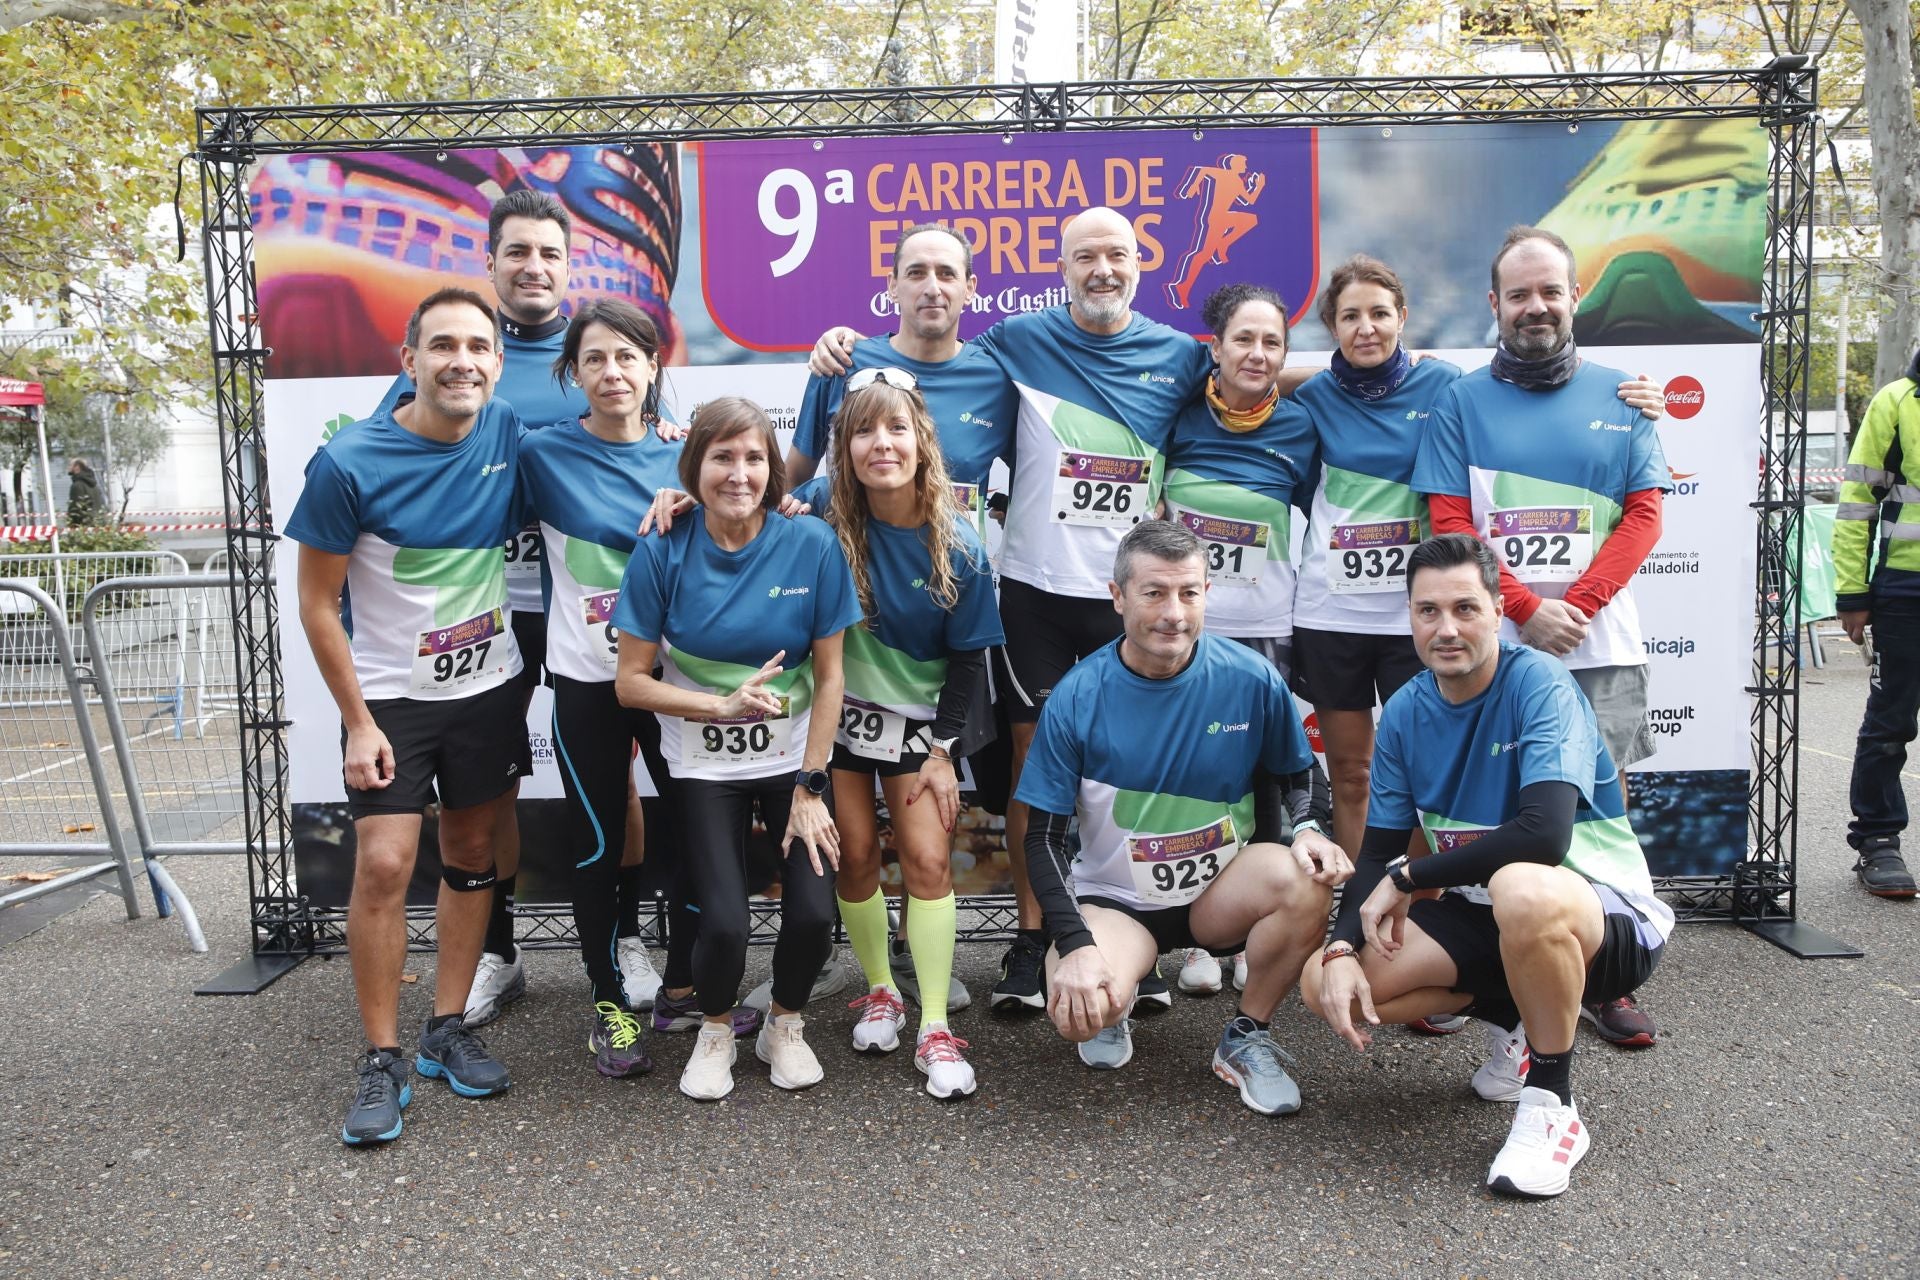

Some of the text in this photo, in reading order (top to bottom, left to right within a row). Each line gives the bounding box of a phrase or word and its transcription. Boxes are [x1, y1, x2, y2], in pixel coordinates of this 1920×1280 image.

[867, 159, 1089, 213] CARRERA
[1104, 158, 1164, 207] DE
[1665, 391, 1702, 404] Coca-Cola
[1603, 423, 1632, 432] Unicaja
[1092, 458, 1119, 467] CARRERA
[1091, 464, 1127, 475] EMPRESAS
[1072, 480, 1132, 513] 926
[1519, 511, 1549, 519] CARRERA
[1204, 519, 1231, 530] CARRERA
[1231, 523, 1240, 531] DE
[1519, 518, 1559, 527] EMPRESAS
[1203, 525, 1239, 538] EMPRESAS
[1356, 526, 1383, 535] CARRERA
[1356, 532, 1393, 542] EMPRESAS
[1504, 535, 1571, 568] 922
[1342, 547, 1406, 579] 932
[782, 586, 809, 596] Unicaja
[451, 621, 475, 635] CARRERA
[451, 627, 482, 643] EMPRESAS
[433, 639, 492, 683] 927
[702, 723, 770, 755] 930
[1164, 835, 1194, 846] CARRERA
[1195, 832, 1204, 841] DE
[1165, 840, 1205, 854] EMPRESAS
[1151, 852, 1220, 892] 923
